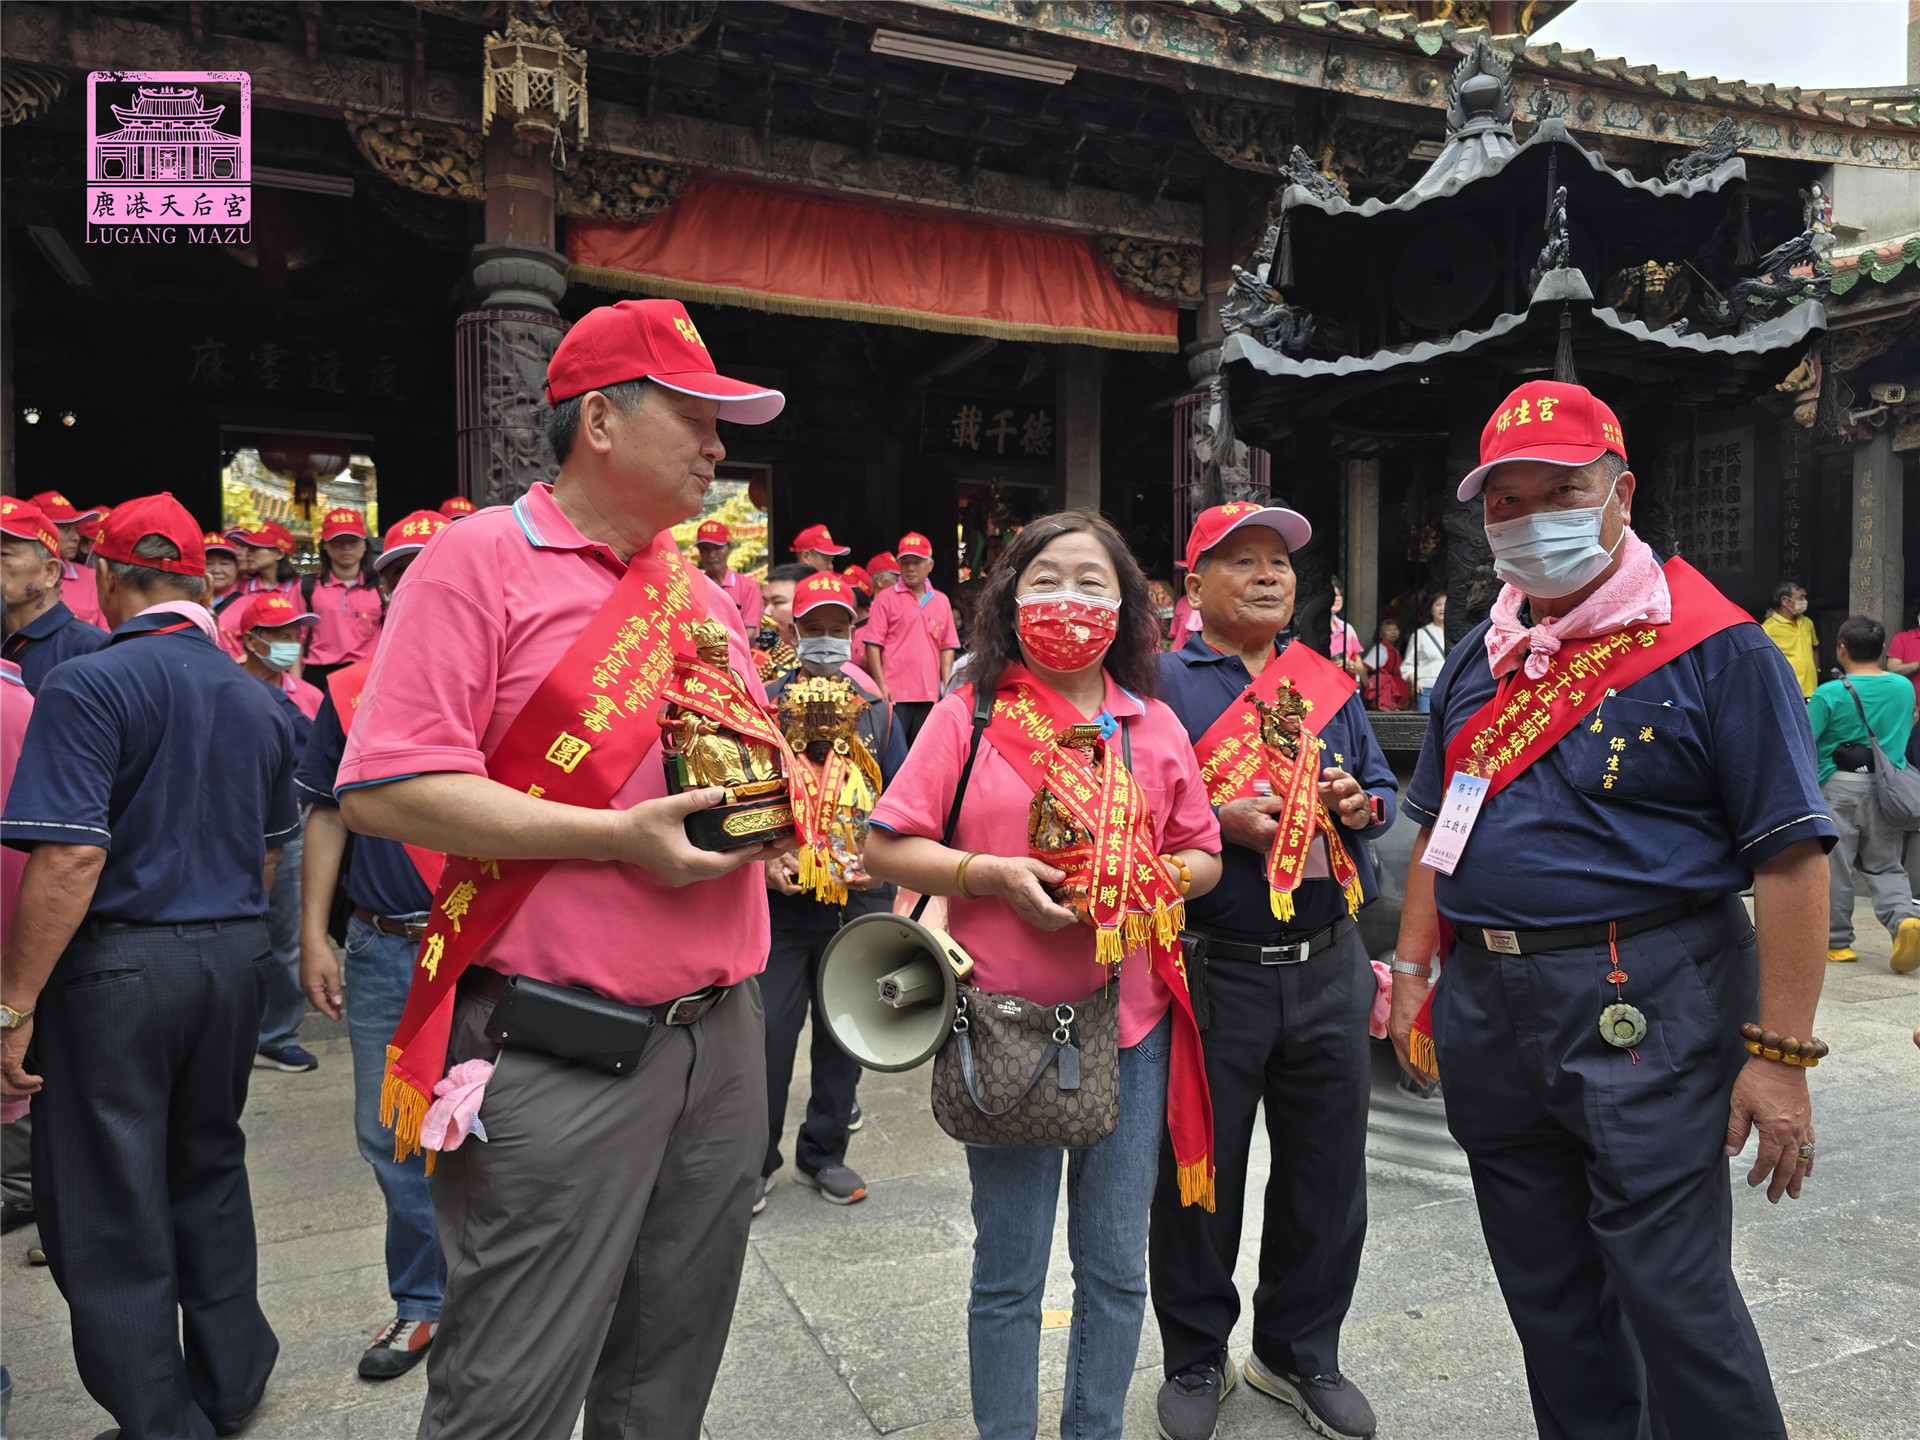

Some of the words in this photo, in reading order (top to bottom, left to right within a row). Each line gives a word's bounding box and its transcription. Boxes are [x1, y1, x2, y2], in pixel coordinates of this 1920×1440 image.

[1496, 396, 1559, 435] 保生宮
[808, 577, 841, 592] 保生宮
[592, 615, 650, 689] 鹿港天后宮
[1635, 629, 1658, 648] 南
[624, 639, 674, 713] 社頭鎮安宮
[1535, 681, 1560, 708] 往
[578, 693, 626, 733] 會香
[1004, 698, 1056, 743] 保生宮
[1471, 688, 1532, 755] 鹿港天后宮
[545, 731, 592, 774] 團
[1200, 737, 1240, 784] 鹿港天后
[1486, 708, 1551, 774] 社頭鎮安宮
[1602, 736, 1627, 790] 保生宮
[1210, 753, 1262, 807] 社頭鎮安宮
[1279, 854, 1297, 874] 贈
[1099, 885, 1119, 908] 贈
